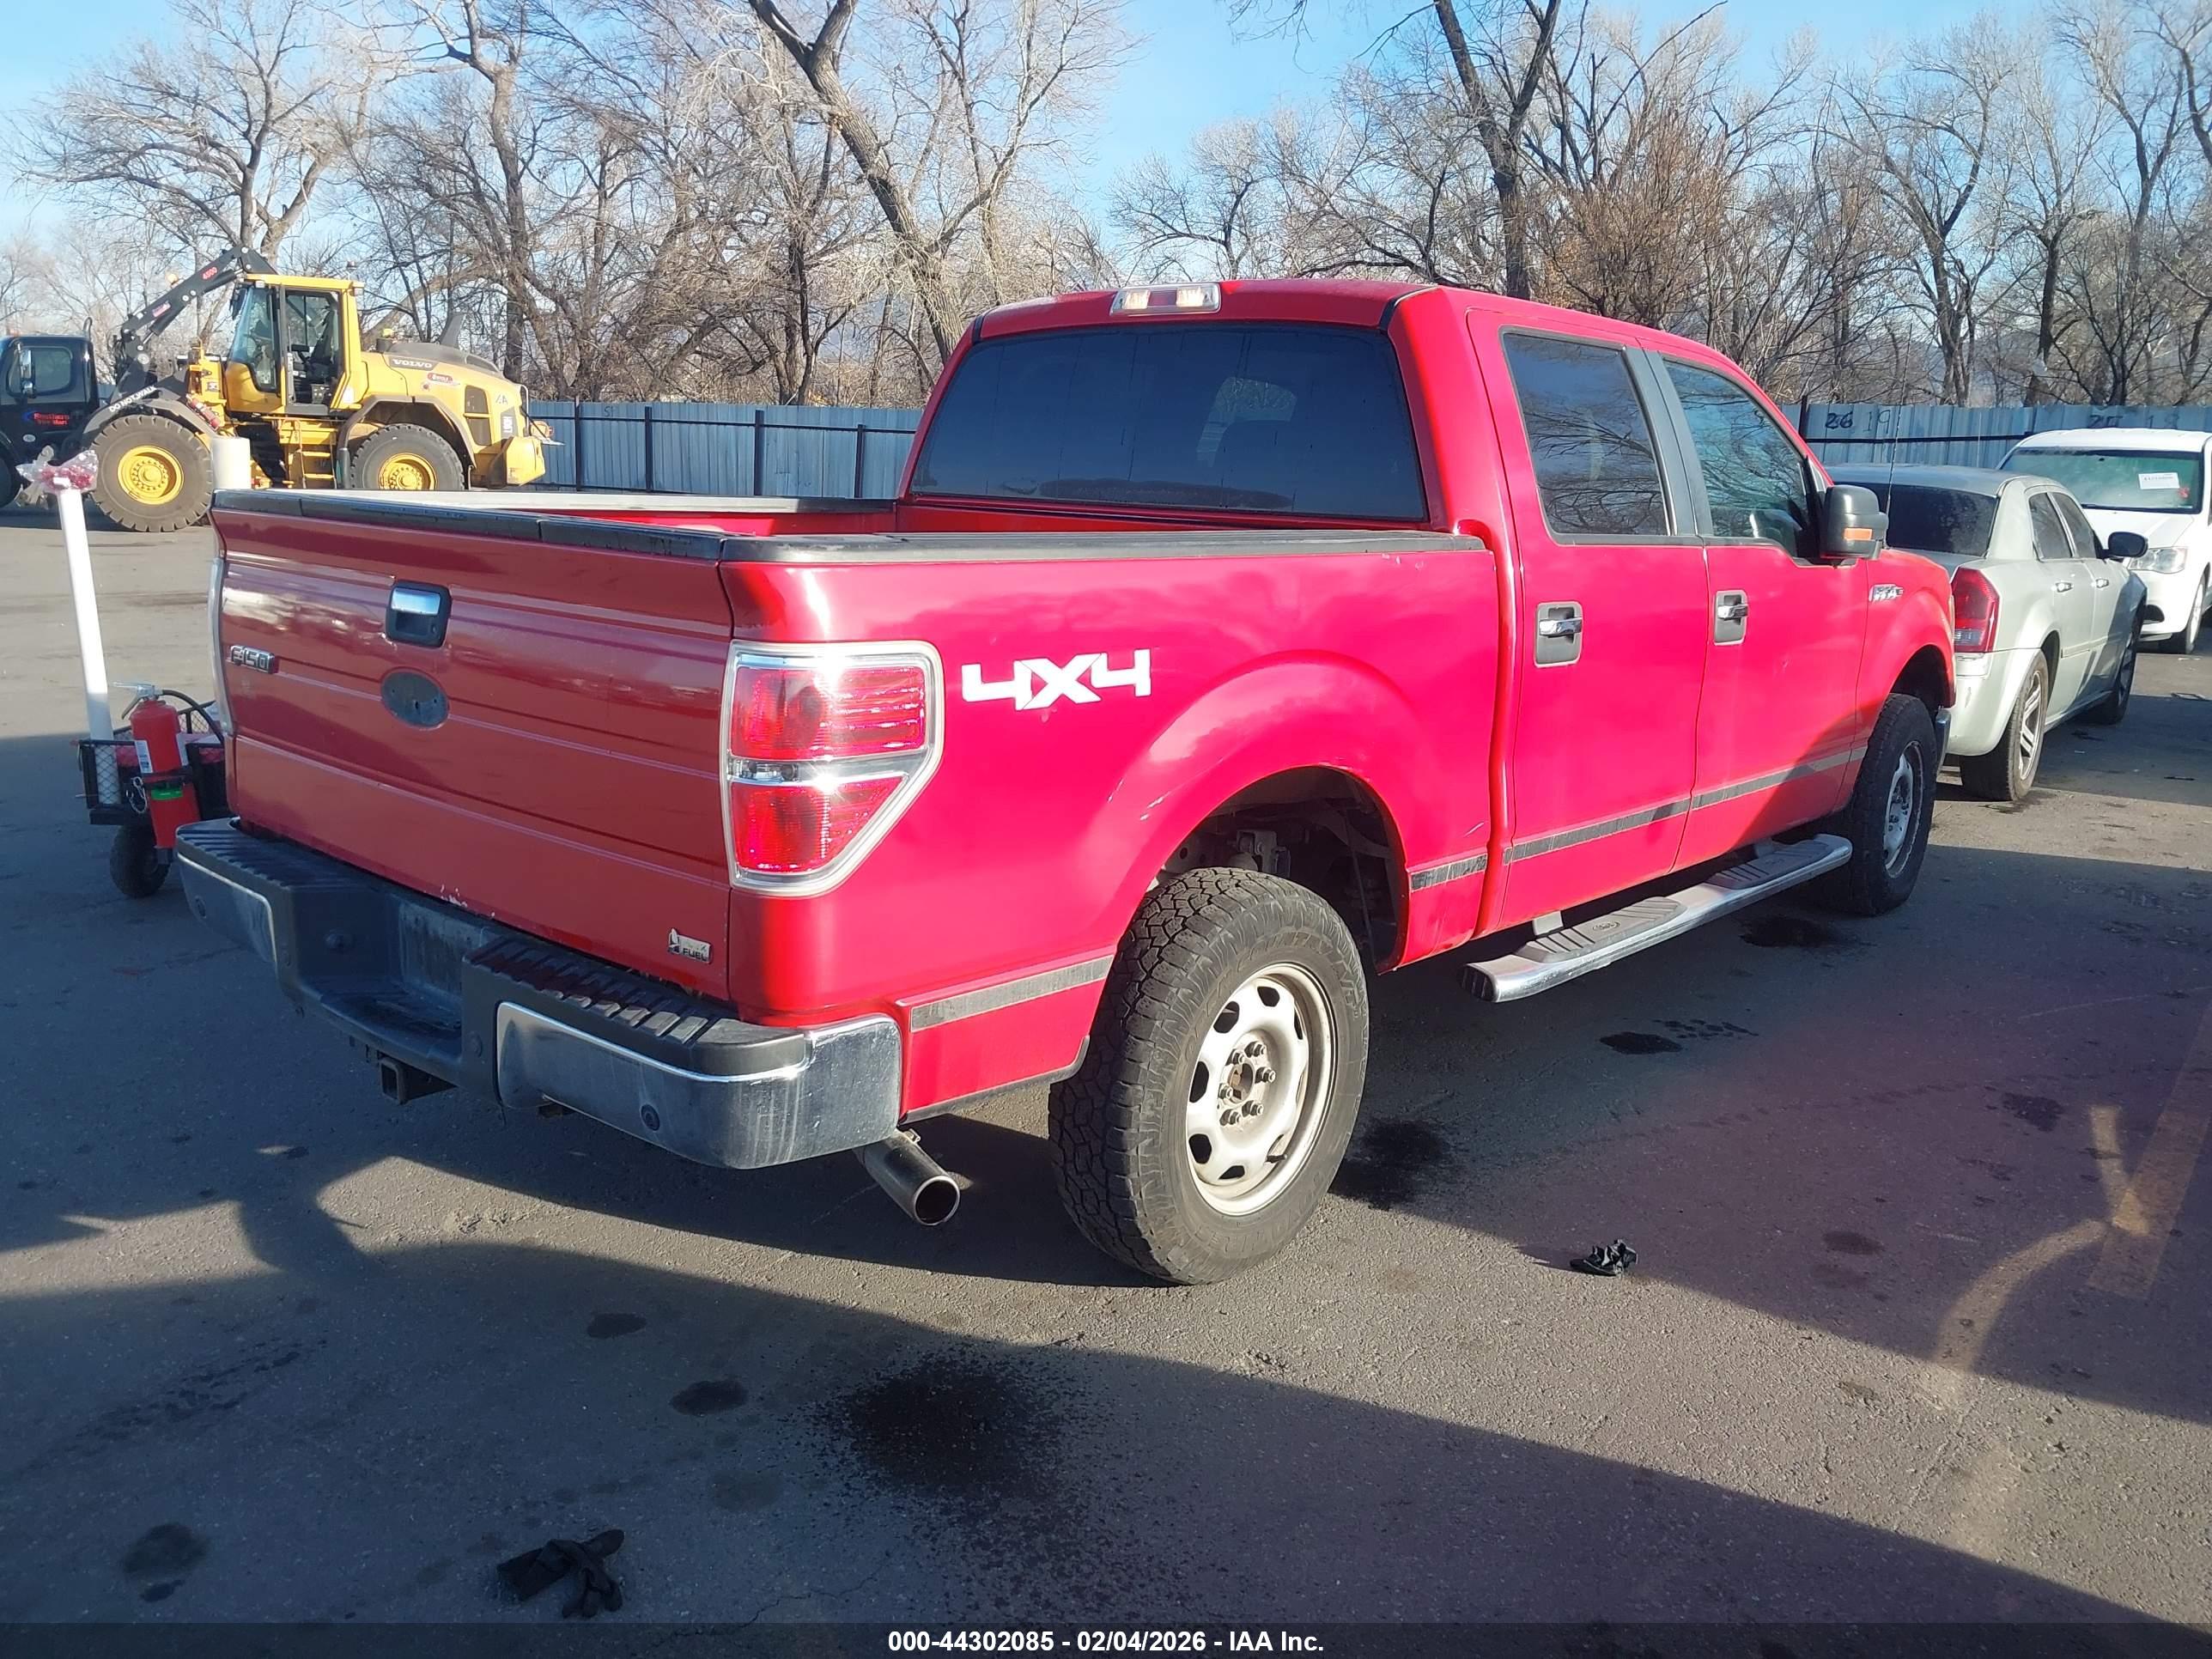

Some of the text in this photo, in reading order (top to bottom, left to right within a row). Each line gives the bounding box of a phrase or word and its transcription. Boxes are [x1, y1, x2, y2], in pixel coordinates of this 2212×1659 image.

[392, 358, 433, 369] VOLVO
[108, 403, 122, 412] DO
[683, 947, 708, 962] FUEL
